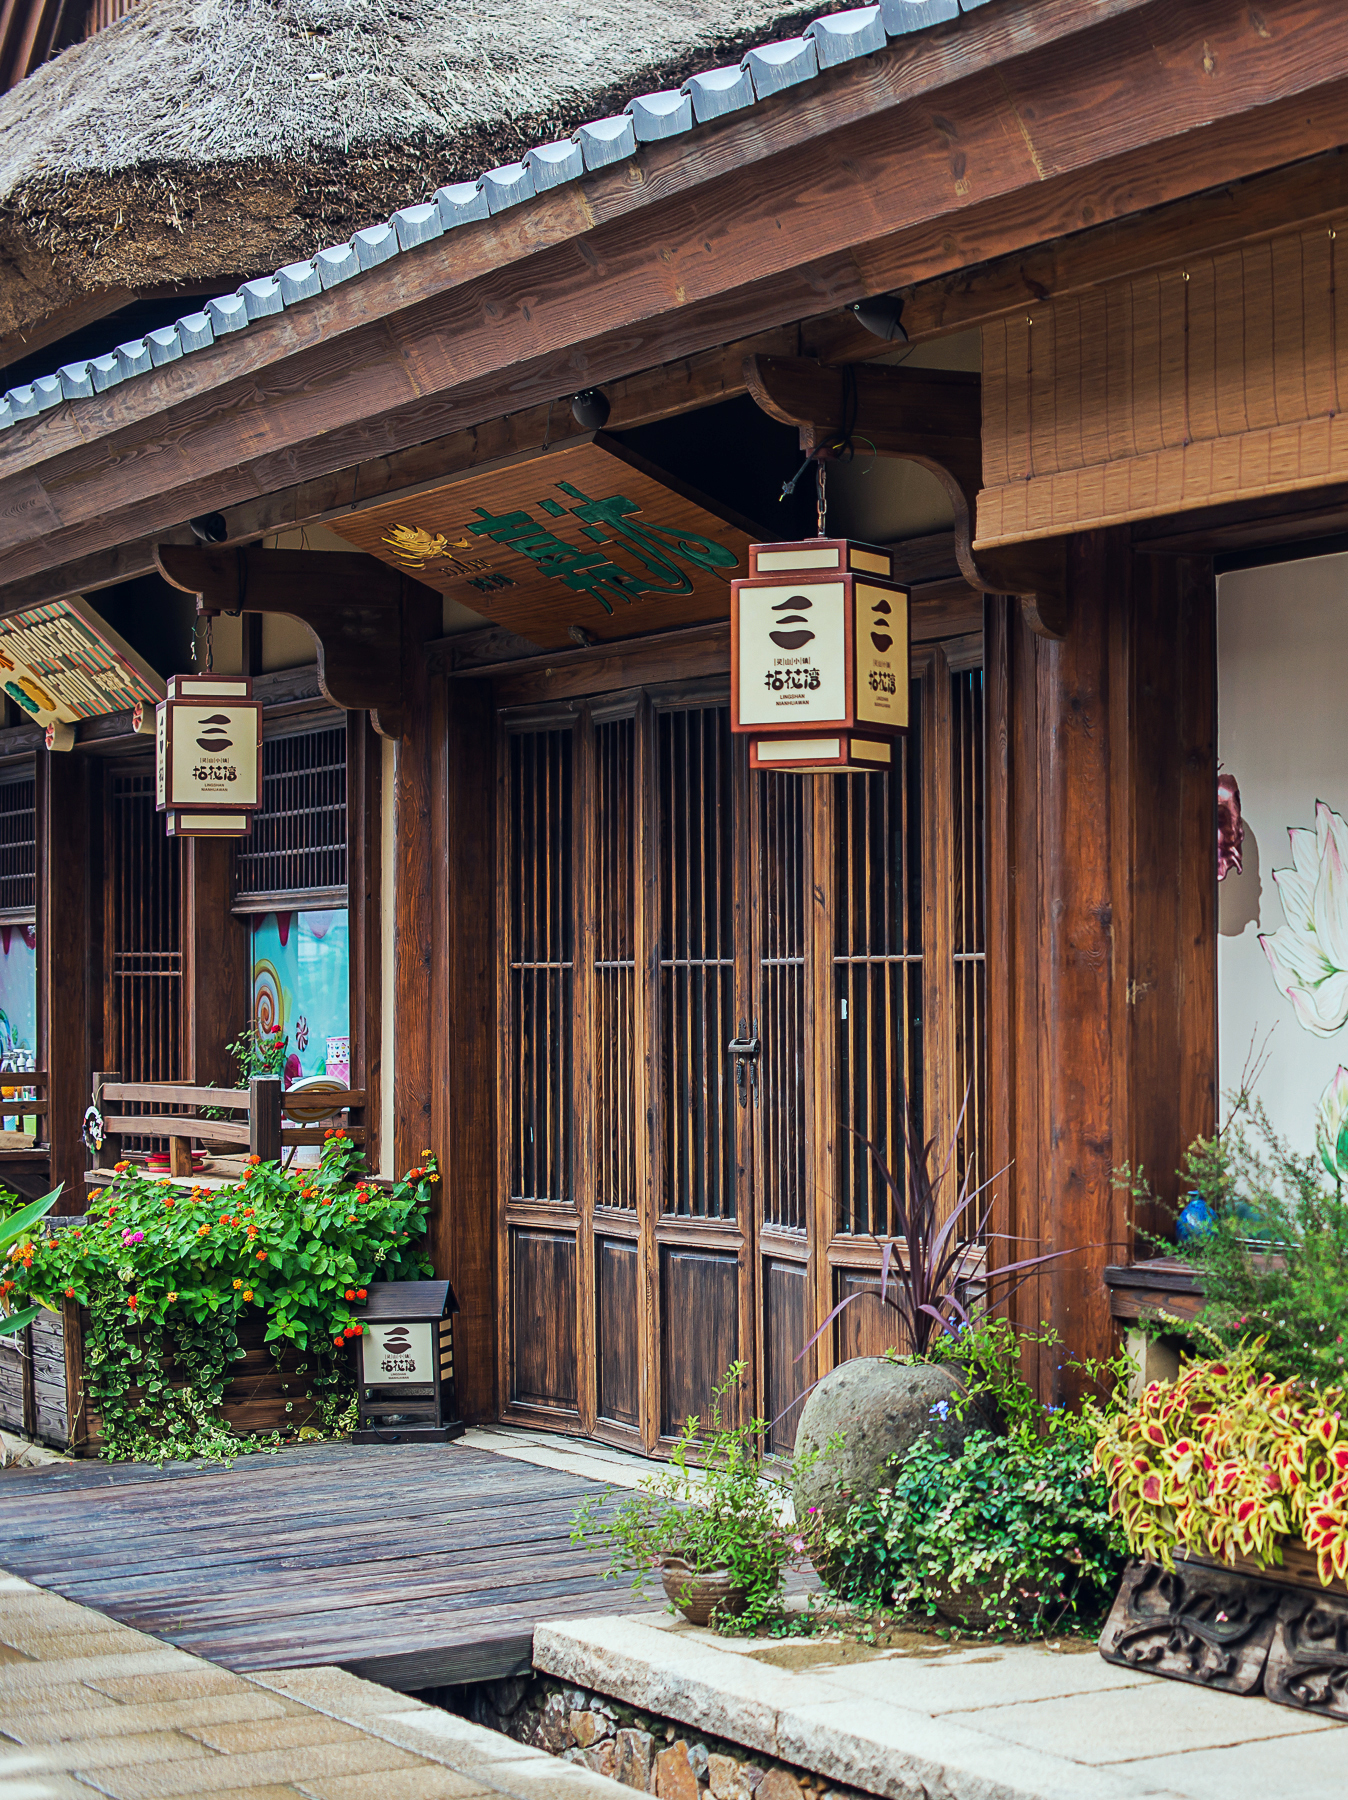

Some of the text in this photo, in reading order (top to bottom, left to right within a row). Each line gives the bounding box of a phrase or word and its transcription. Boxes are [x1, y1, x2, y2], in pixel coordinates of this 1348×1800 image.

[40, 660, 113, 708] candy
[764, 667, 821, 691] 拈花湾
[868, 670, 897, 696] 拈花湾
[192, 765, 237, 782] 拈花湾
[381, 1360, 416, 1372] 拈花湾
